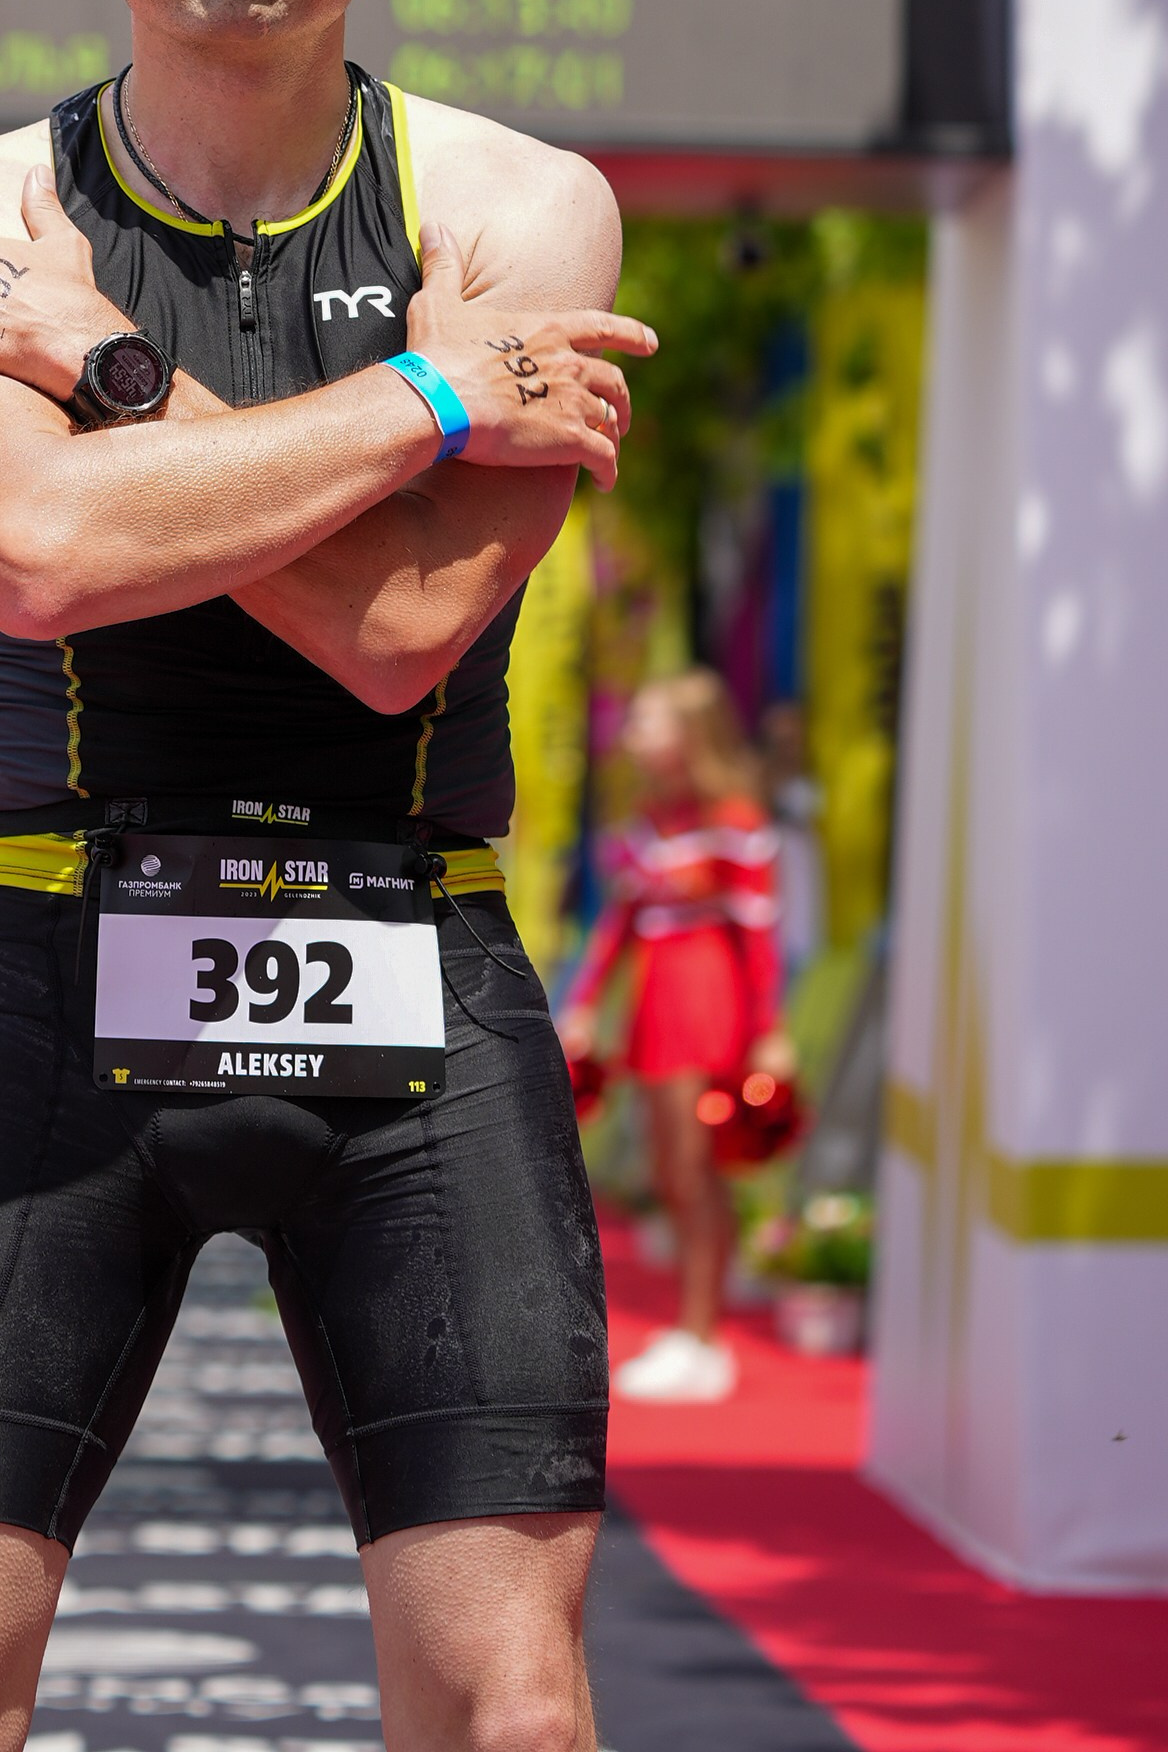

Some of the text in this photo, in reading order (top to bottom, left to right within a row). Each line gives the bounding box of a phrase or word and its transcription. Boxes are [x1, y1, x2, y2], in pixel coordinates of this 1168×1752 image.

[313, 285, 396, 322] TYR
[484, 335, 549, 406] 392
[232, 799, 311, 822] IRON STAR
[220, 859, 329, 883] IRON STAR
[118, 880, 182, 891] ГАЗПРОМБАНК
[128, 889, 172, 898] ПРЕМИУМ
[366, 875, 415, 891] МАГНИТ
[189, 938, 353, 1025] 392
[217, 1052, 324, 1078] ALEKSEY
[408, 1080, 427, 1093] 113
